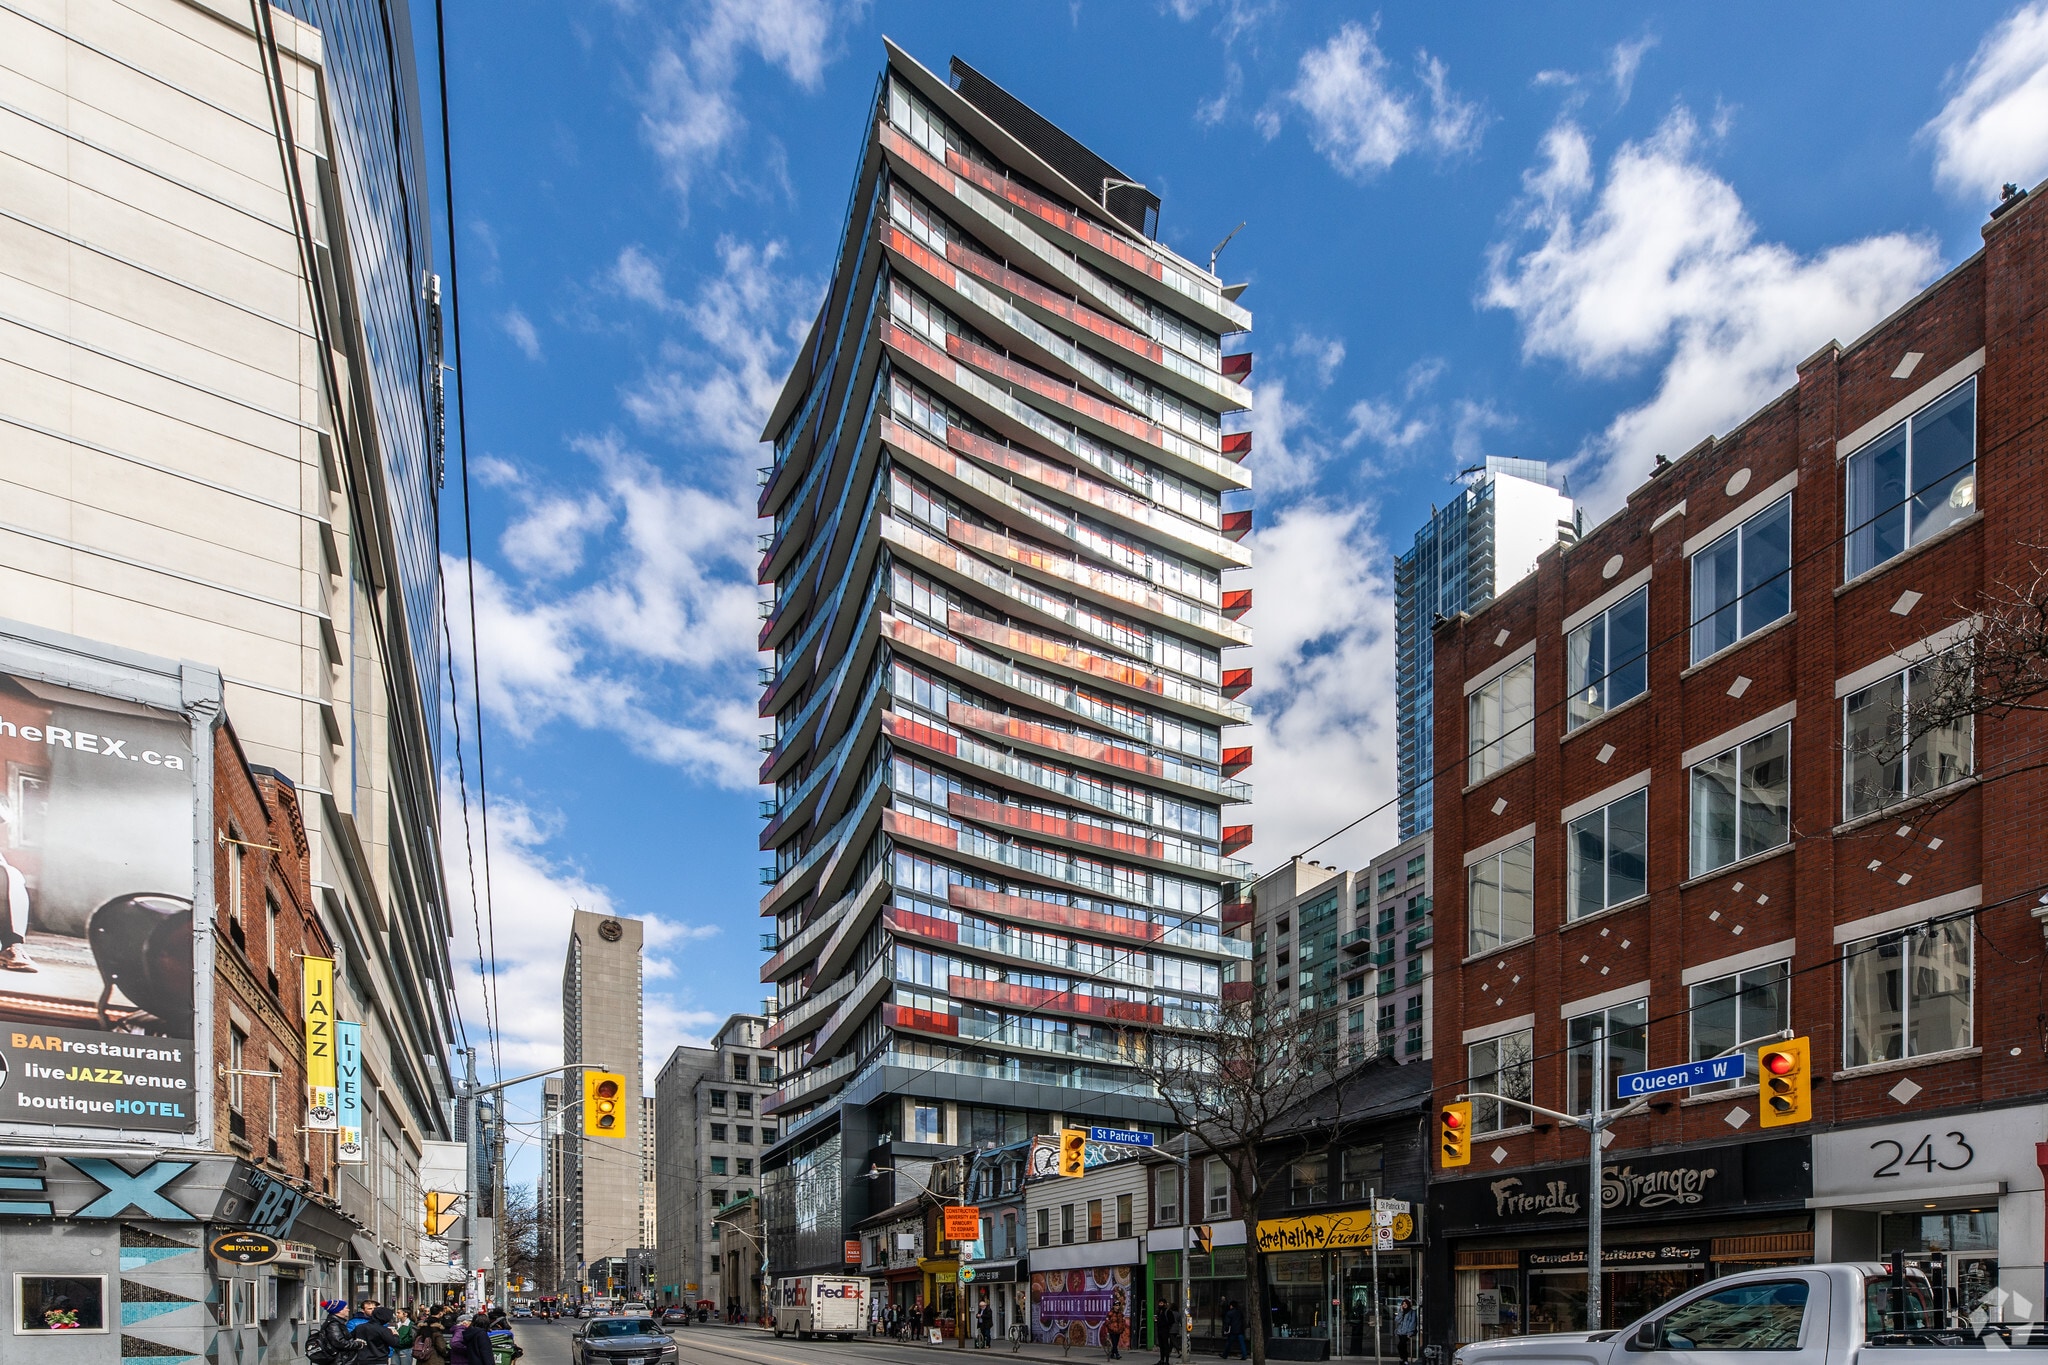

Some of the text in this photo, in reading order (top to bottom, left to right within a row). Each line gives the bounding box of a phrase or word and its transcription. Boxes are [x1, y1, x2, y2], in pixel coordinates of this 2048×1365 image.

[310, 980, 328, 1057] JAZZ
[11, 1032, 182, 1062] BARrestaurant
[25, 1062, 187, 1089] liveJAZZvenue
[343, 1034, 356, 1109] LIVES
[1631, 1062, 1728, 1092] Queen St W
[18, 1092, 185, 1117] boutiqueHOTEL
[1097, 1129, 1107, 1139] St
[1109, 1130, 1141, 1142] Patrick
[1870, 1131, 1974, 1178] 243
[250, 1169, 269, 1191] THE
[1490, 1165, 1716, 1216] Friendly Stranger
[246, 1181, 310, 1239] REX
[1380, 1201, 1385, 1209] St
[1386, 1202, 1400, 1210] Patrick
[1256, 1220, 1325, 1250] drenaline
[1323, 1216, 1372, 1248] Toronto
[1661, 1246, 1701, 1260] Shop
[783, 1280, 807, 1307] FedEx
[817, 1284, 864, 1299] FedEx
